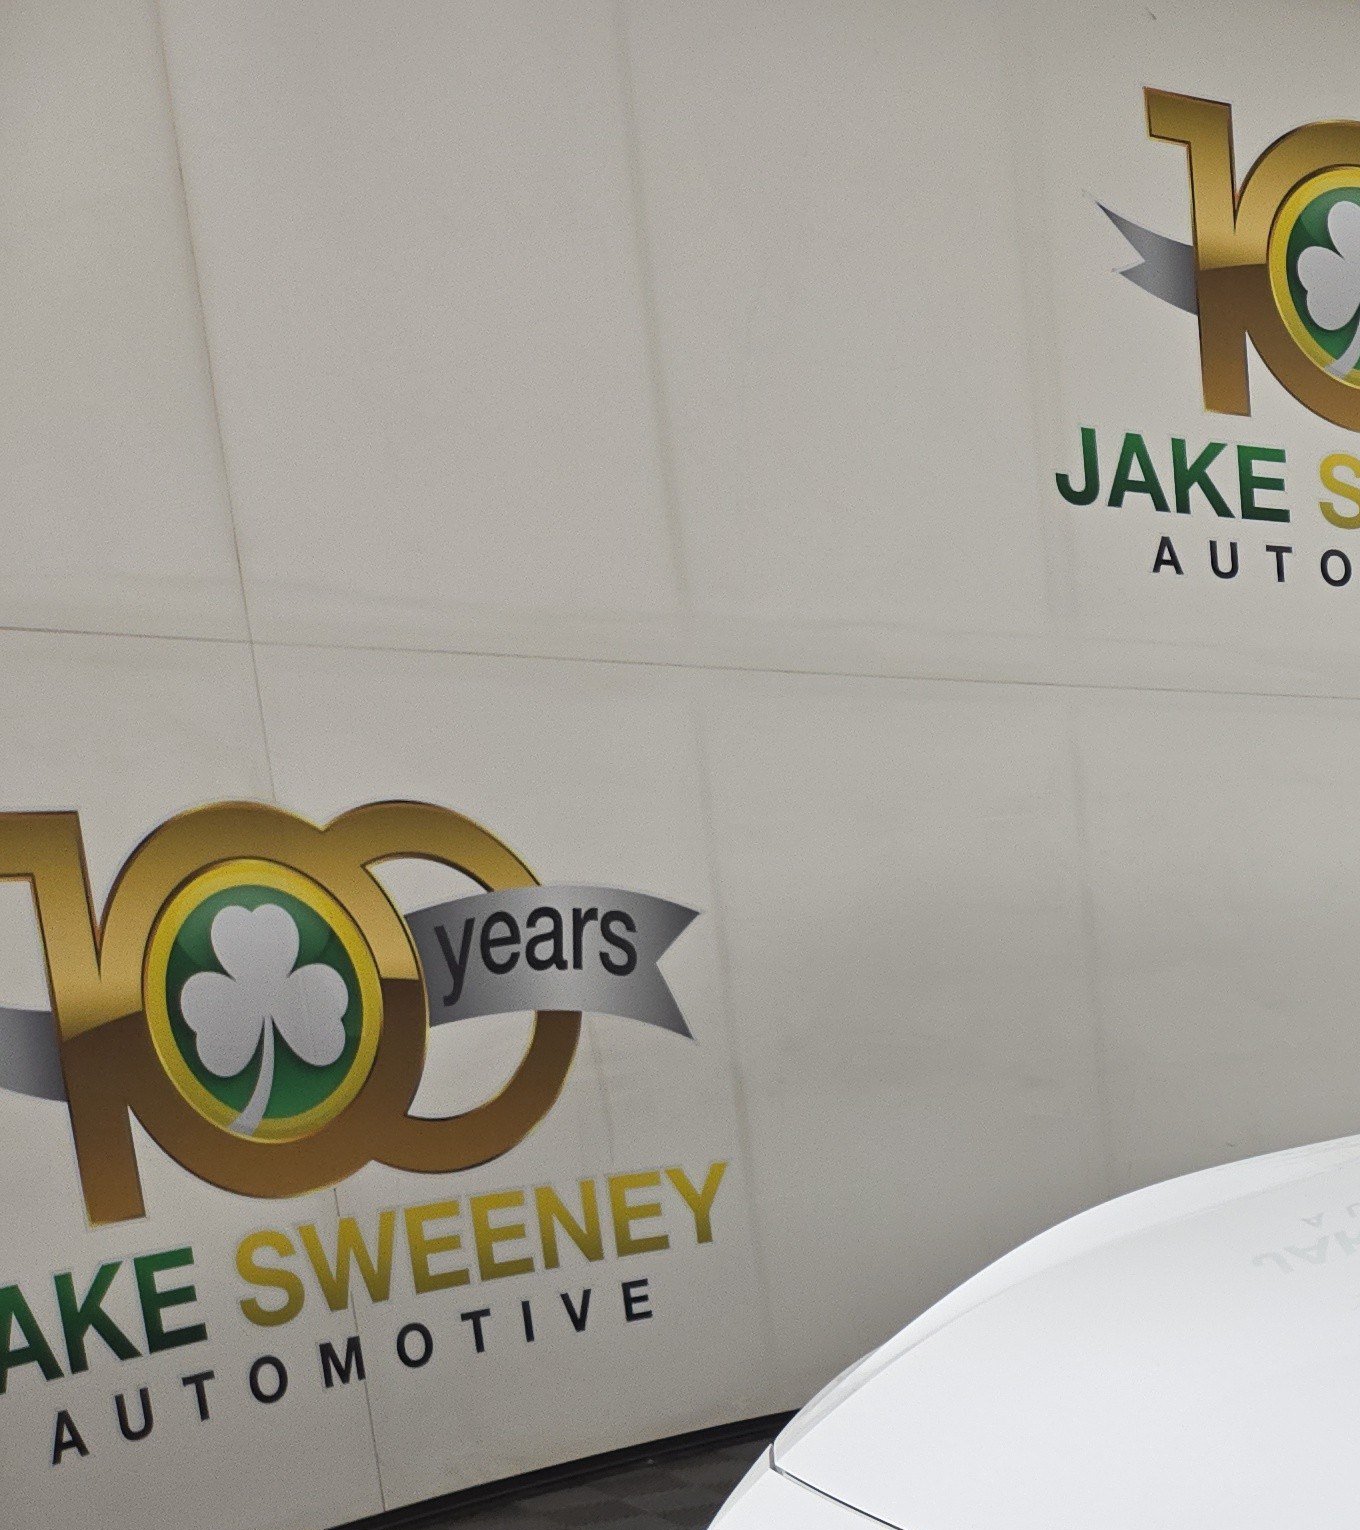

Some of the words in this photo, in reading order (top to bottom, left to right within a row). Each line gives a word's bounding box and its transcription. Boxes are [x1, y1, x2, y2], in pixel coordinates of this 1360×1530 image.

[1055, 426, 1291, 524] JAKE
[433, 906, 639, 1005] years
[0, 1245, 209, 1395] AKE
[234, 1161, 729, 1329] SWEENEY
[51, 1278, 654, 1465] AUTOMOTIVE
